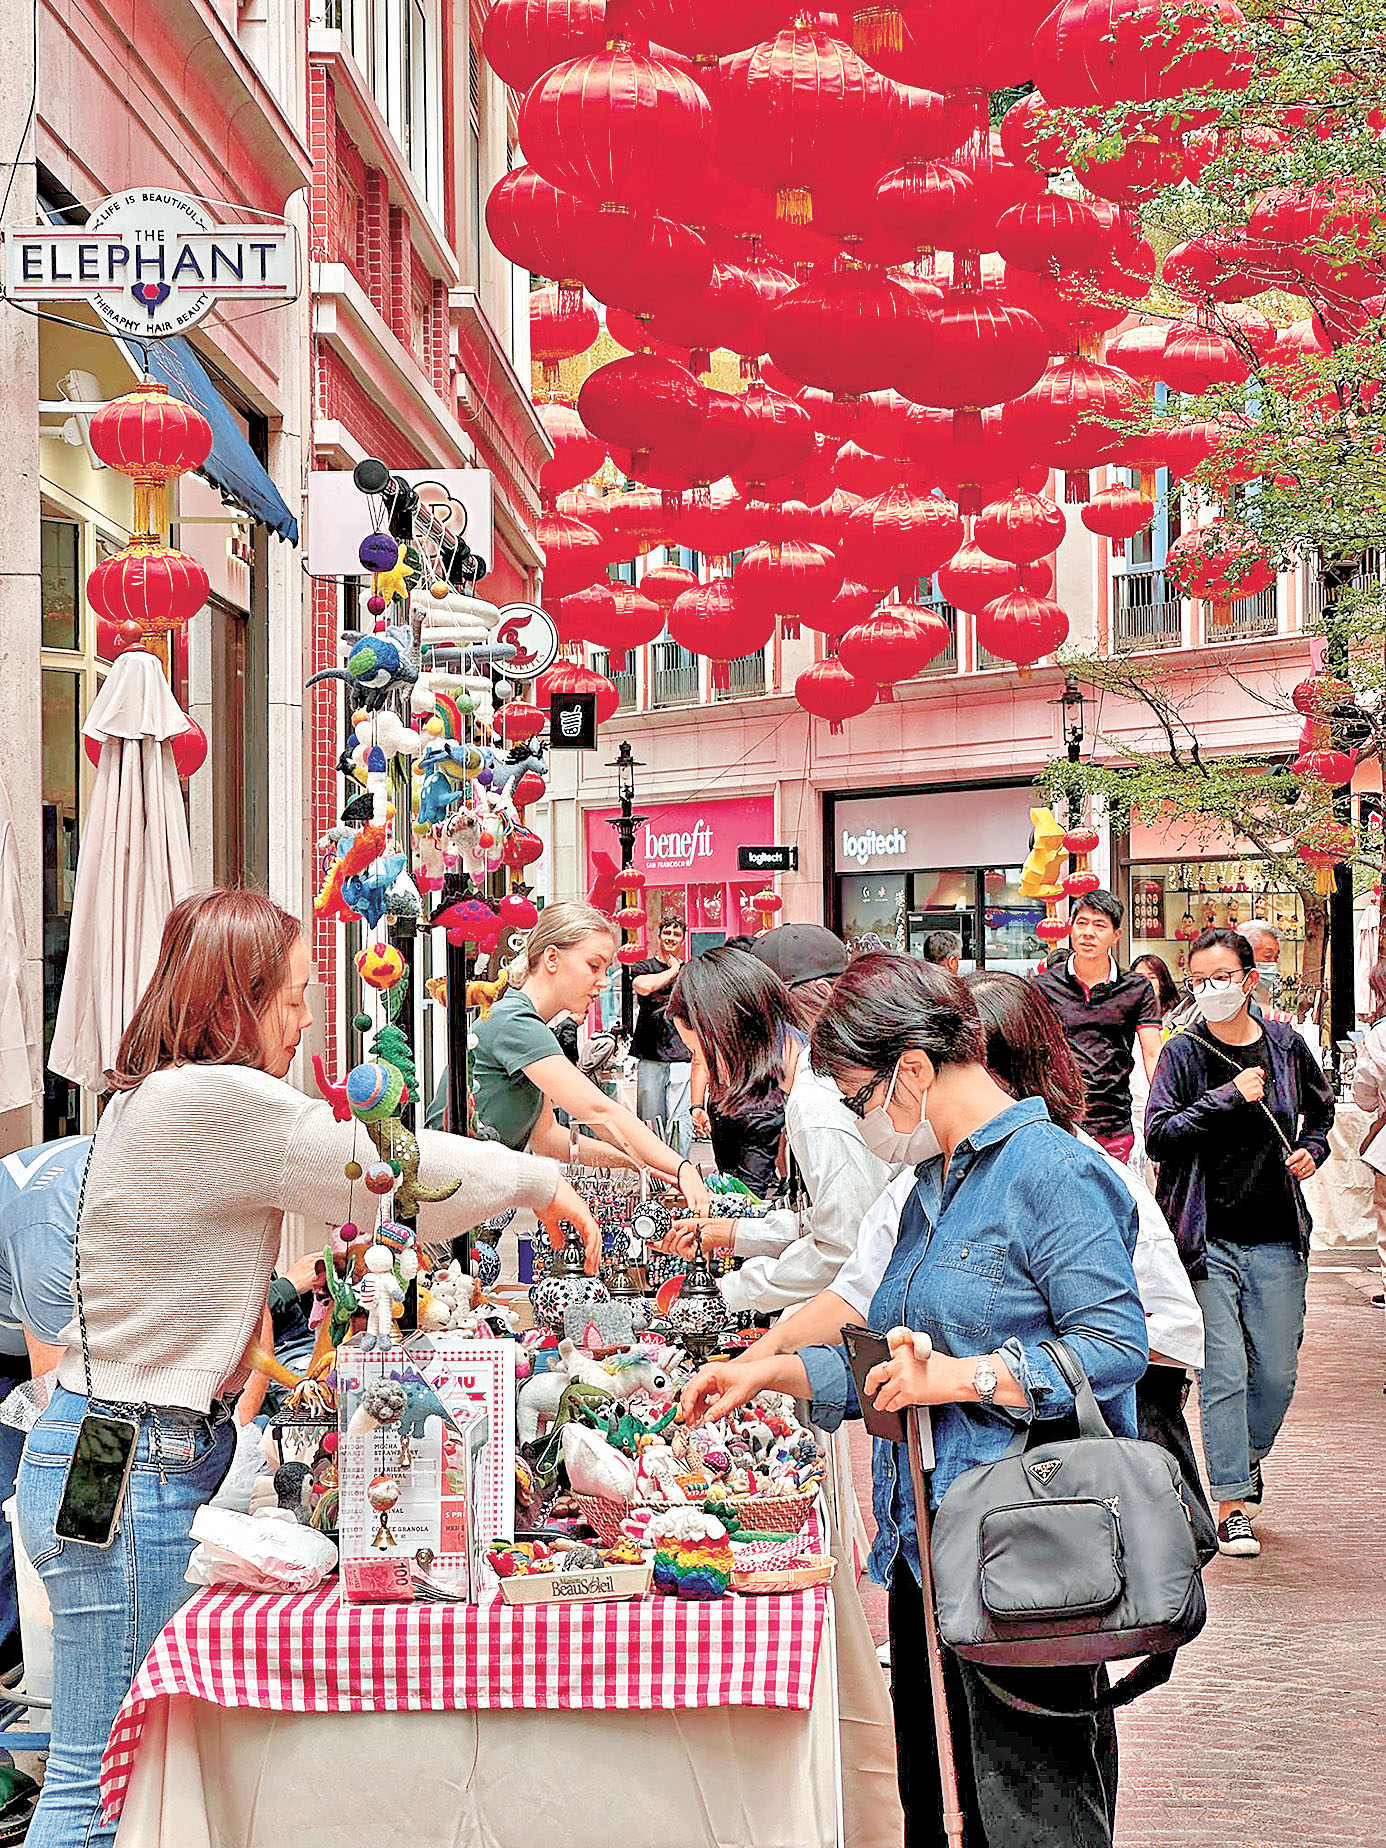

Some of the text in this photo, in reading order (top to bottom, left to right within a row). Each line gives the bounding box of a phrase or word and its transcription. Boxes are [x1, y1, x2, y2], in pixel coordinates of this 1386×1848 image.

[100, 193, 198, 222] LIFE IS BEAUTIFUL
[135, 229, 166, 242] THE
[22, 243, 277, 282] ELEPHANT
[93, 291, 209, 333] THERAPHY HAIR BEAUTY
[644, 818, 714, 867] benefit
[841, 826, 907, 865] logitech
[657, 860, 686, 869] FRANCISCO
[748, 852, 783, 866] logitech
[393, 1562, 409, 1586] 100
